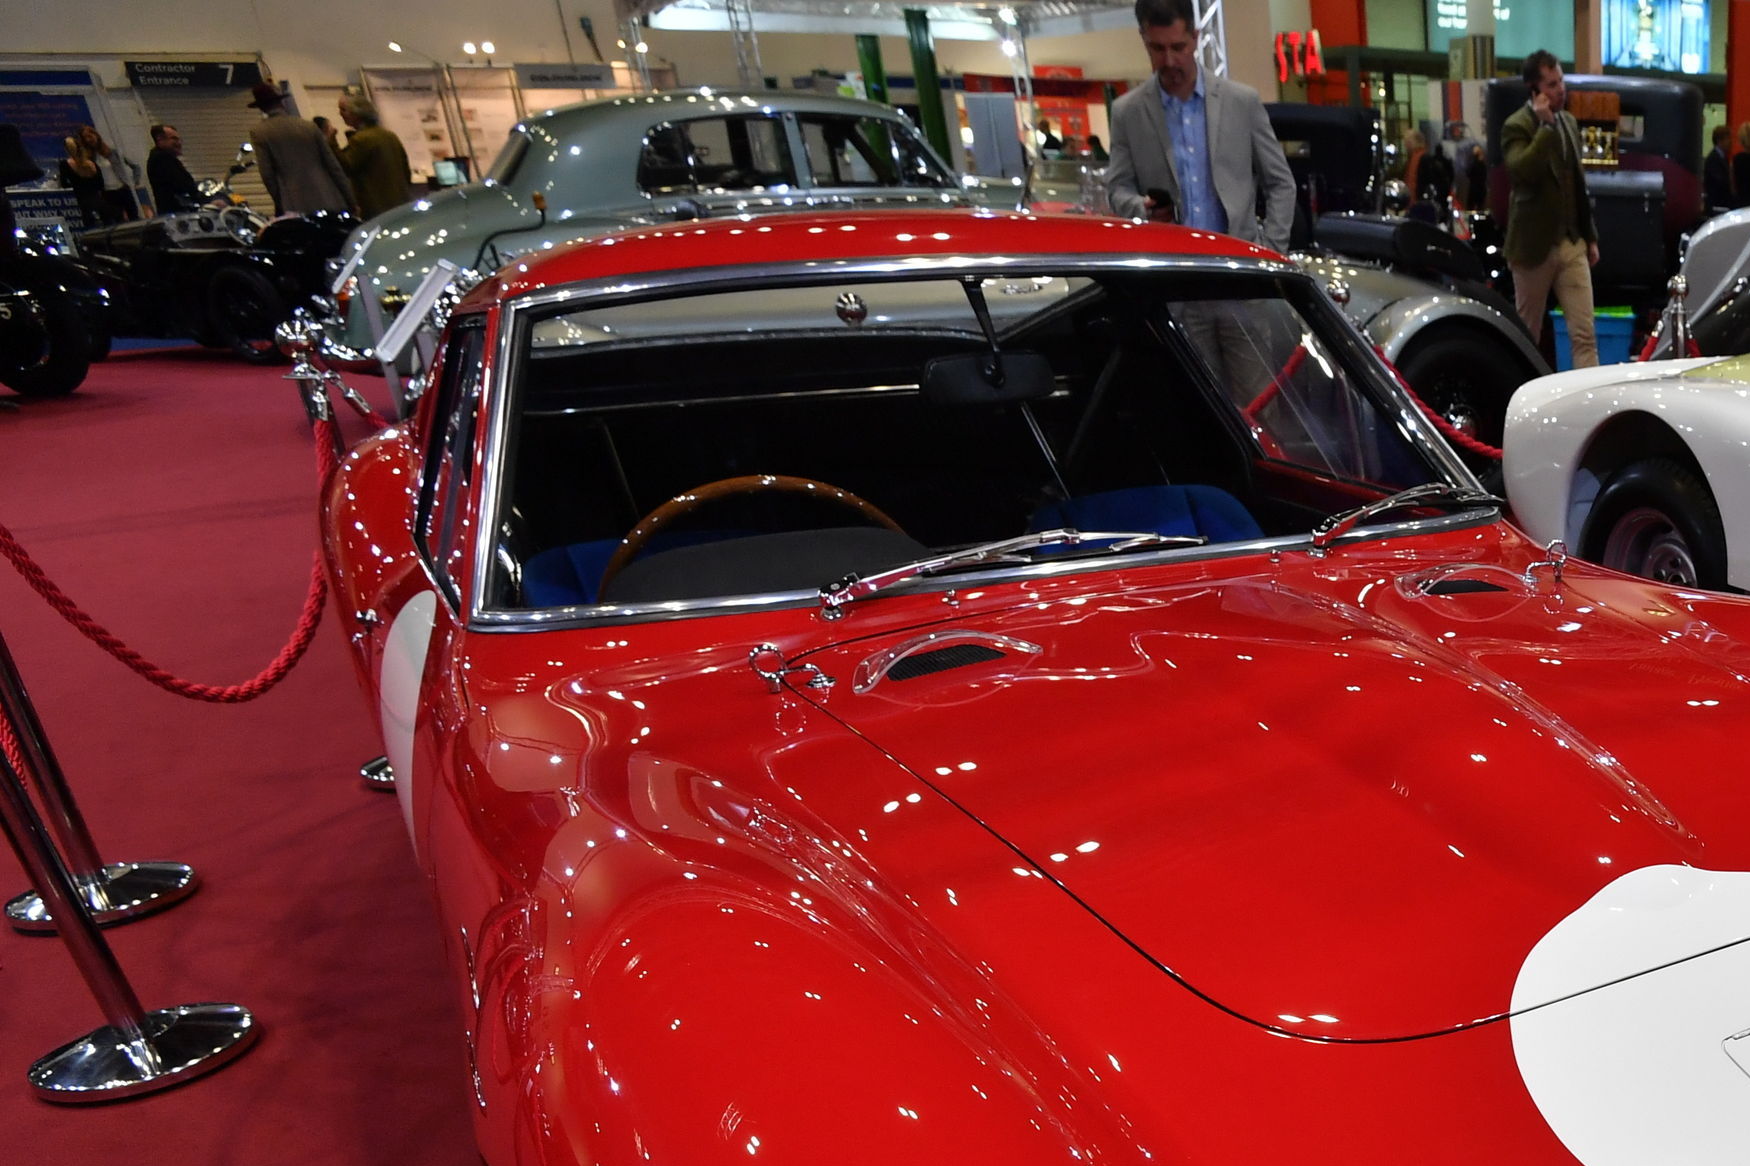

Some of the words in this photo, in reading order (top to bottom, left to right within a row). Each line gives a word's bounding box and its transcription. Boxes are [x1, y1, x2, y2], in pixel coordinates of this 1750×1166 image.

[135, 63, 195, 73] Contractor
[218, 64, 235, 85] 7
[139, 76, 189, 85] Entrance
